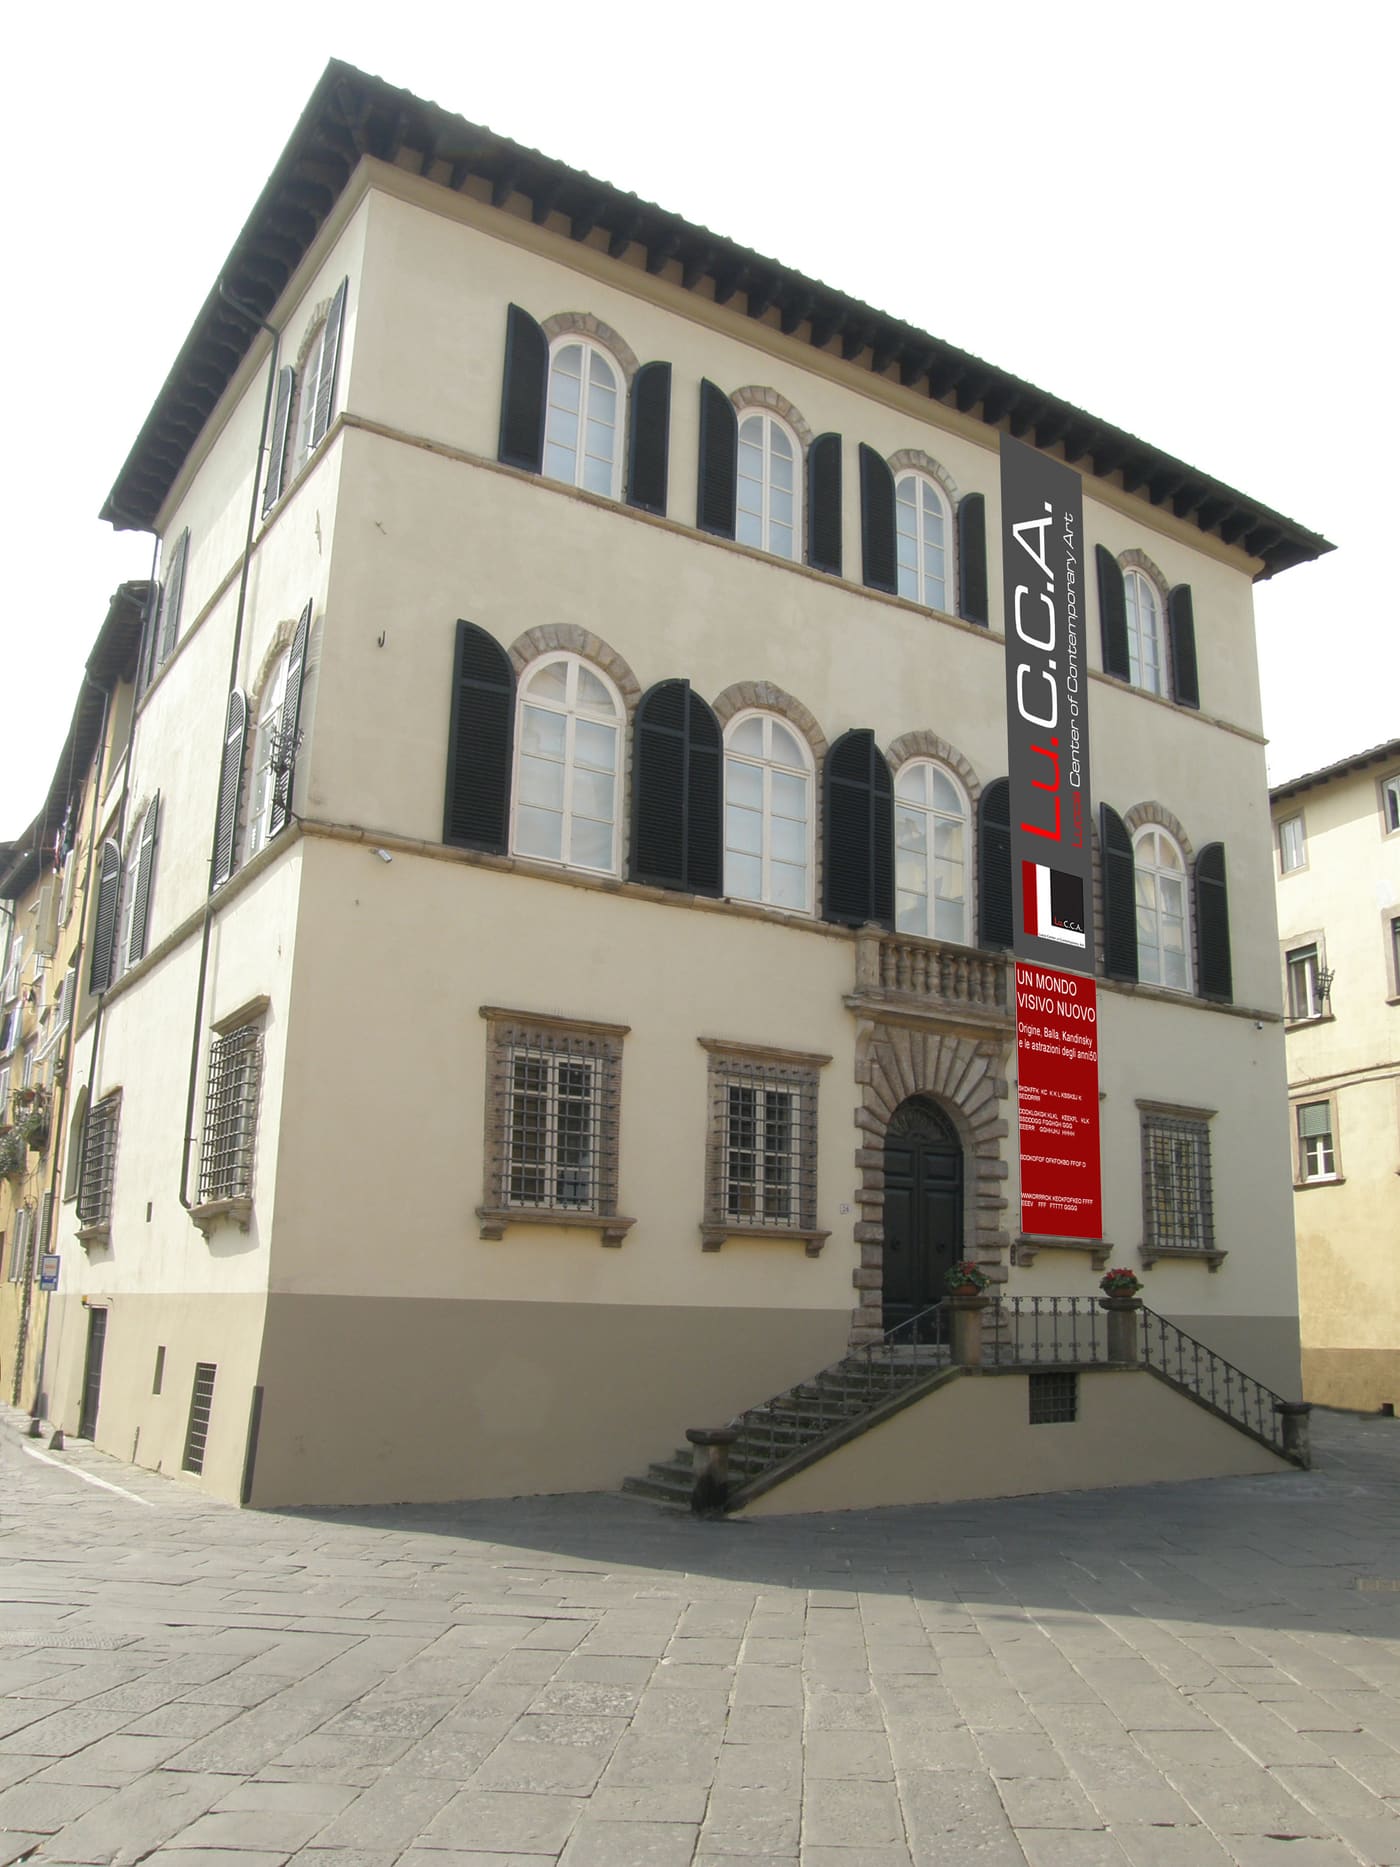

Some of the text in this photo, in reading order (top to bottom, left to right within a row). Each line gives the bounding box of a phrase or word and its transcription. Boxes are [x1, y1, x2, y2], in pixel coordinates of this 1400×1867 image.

[1063, 512, 1074, 549] Art
[1066, 550, 1078, 693] Contemporary
[1067, 695, 1079, 717] of
[1070, 719, 1081, 788] Center
[1017, 968, 1077, 996] UN MONDO
[1017, 991, 1096, 1022] VISIVO NUOVO
[1018, 1039, 1023, 1048] e
[1024, 1038, 1030, 1049] le
[1031, 1041, 1060, 1055] astrazioni
[1061, 1046, 1077, 1060] degli
[1062, 1031, 1092, 1048] Kandinsky
